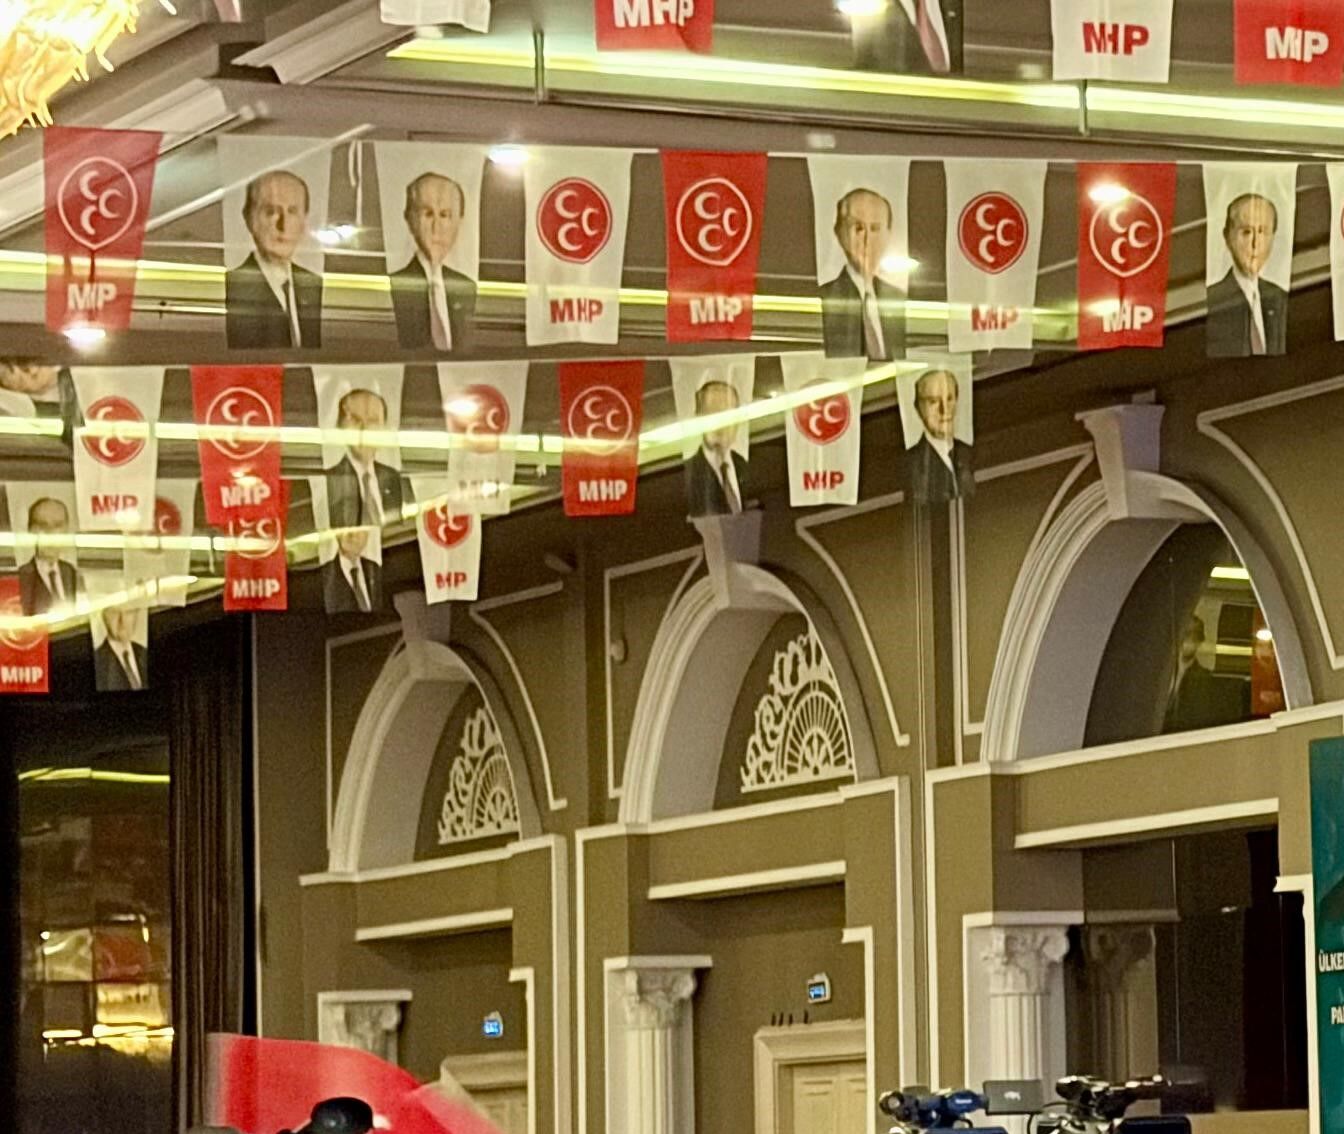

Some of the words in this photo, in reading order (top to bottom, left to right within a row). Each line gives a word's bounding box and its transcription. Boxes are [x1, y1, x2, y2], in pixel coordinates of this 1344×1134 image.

[578, 479, 628, 502] MHP
[232, 578, 280, 599] MHP
[0, 666, 43, 684] MHP
